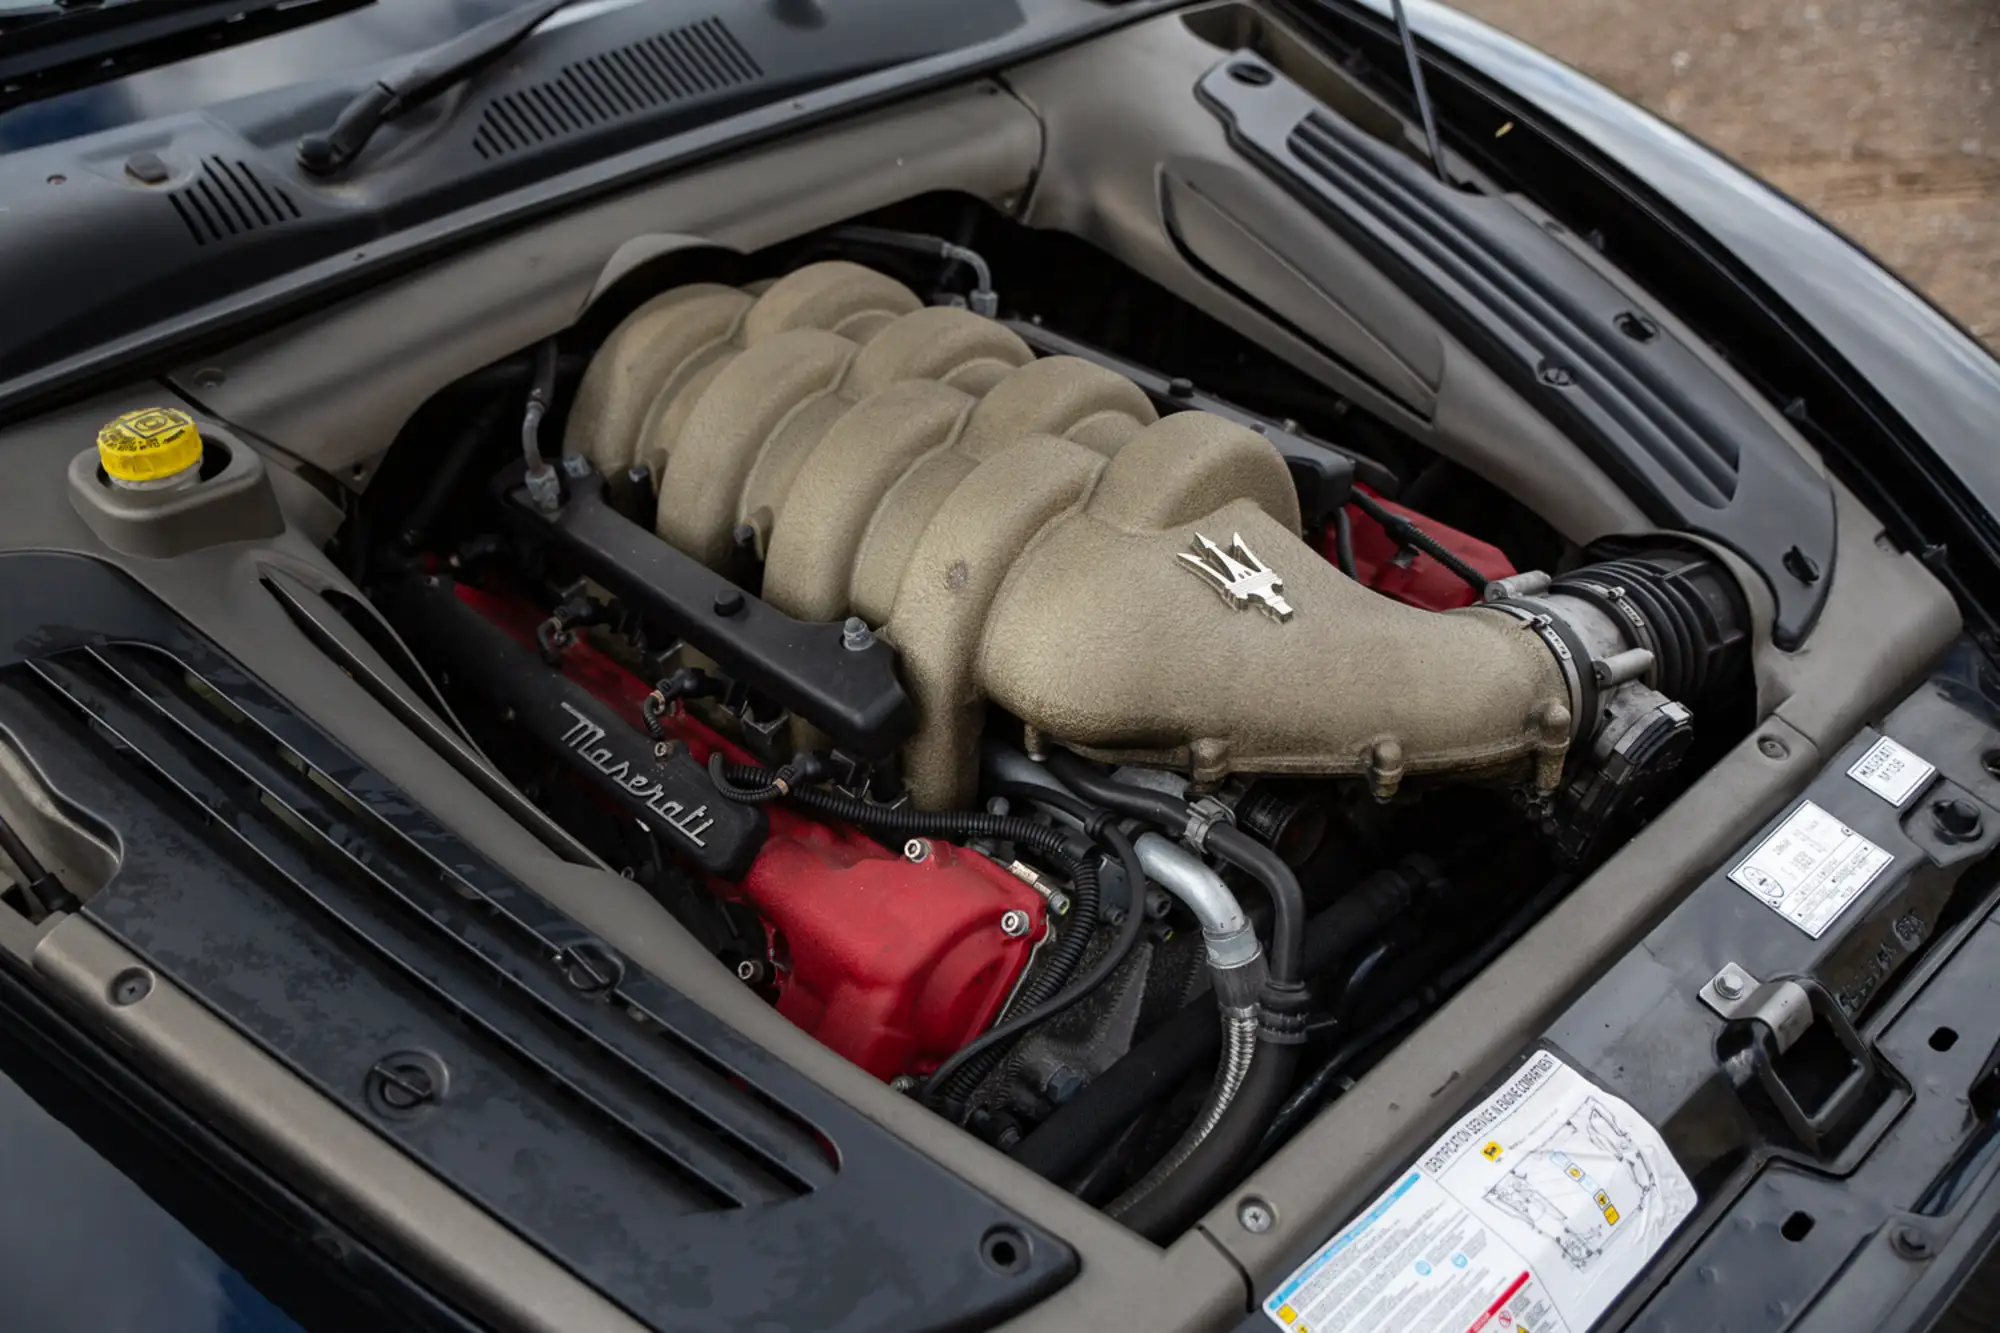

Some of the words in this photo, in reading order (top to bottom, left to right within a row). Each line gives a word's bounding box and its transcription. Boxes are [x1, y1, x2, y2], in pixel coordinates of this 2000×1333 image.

[560, 701, 714, 848] Maserati
[1860, 744, 1897, 779] MASERATI
[1424, 1127, 1472, 1173] IDENTIFICATION
[1465, 1108, 1497, 1135] SERVICE
[1496, 1086, 1522, 1112] ENGINE
[1515, 1053, 1555, 1094] COMPARTMENT
